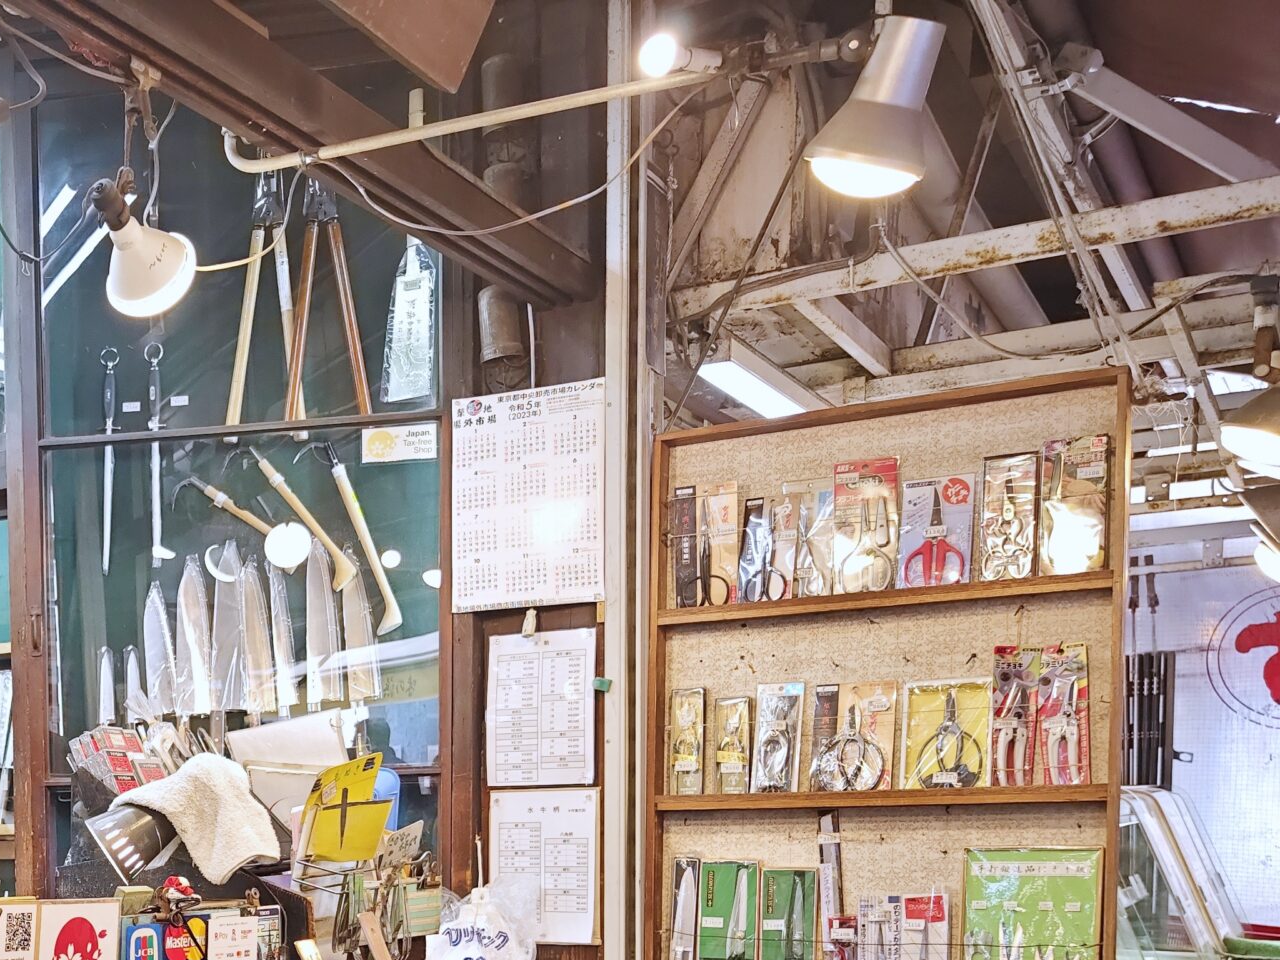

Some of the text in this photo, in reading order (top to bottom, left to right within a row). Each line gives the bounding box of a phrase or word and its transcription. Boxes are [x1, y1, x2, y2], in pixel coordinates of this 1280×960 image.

[405, 429, 432, 439] Japan.
[402, 438, 433, 447] Tax-free
[413, 446, 433, 455] Shop
[134, 947, 154, 957] JCB
